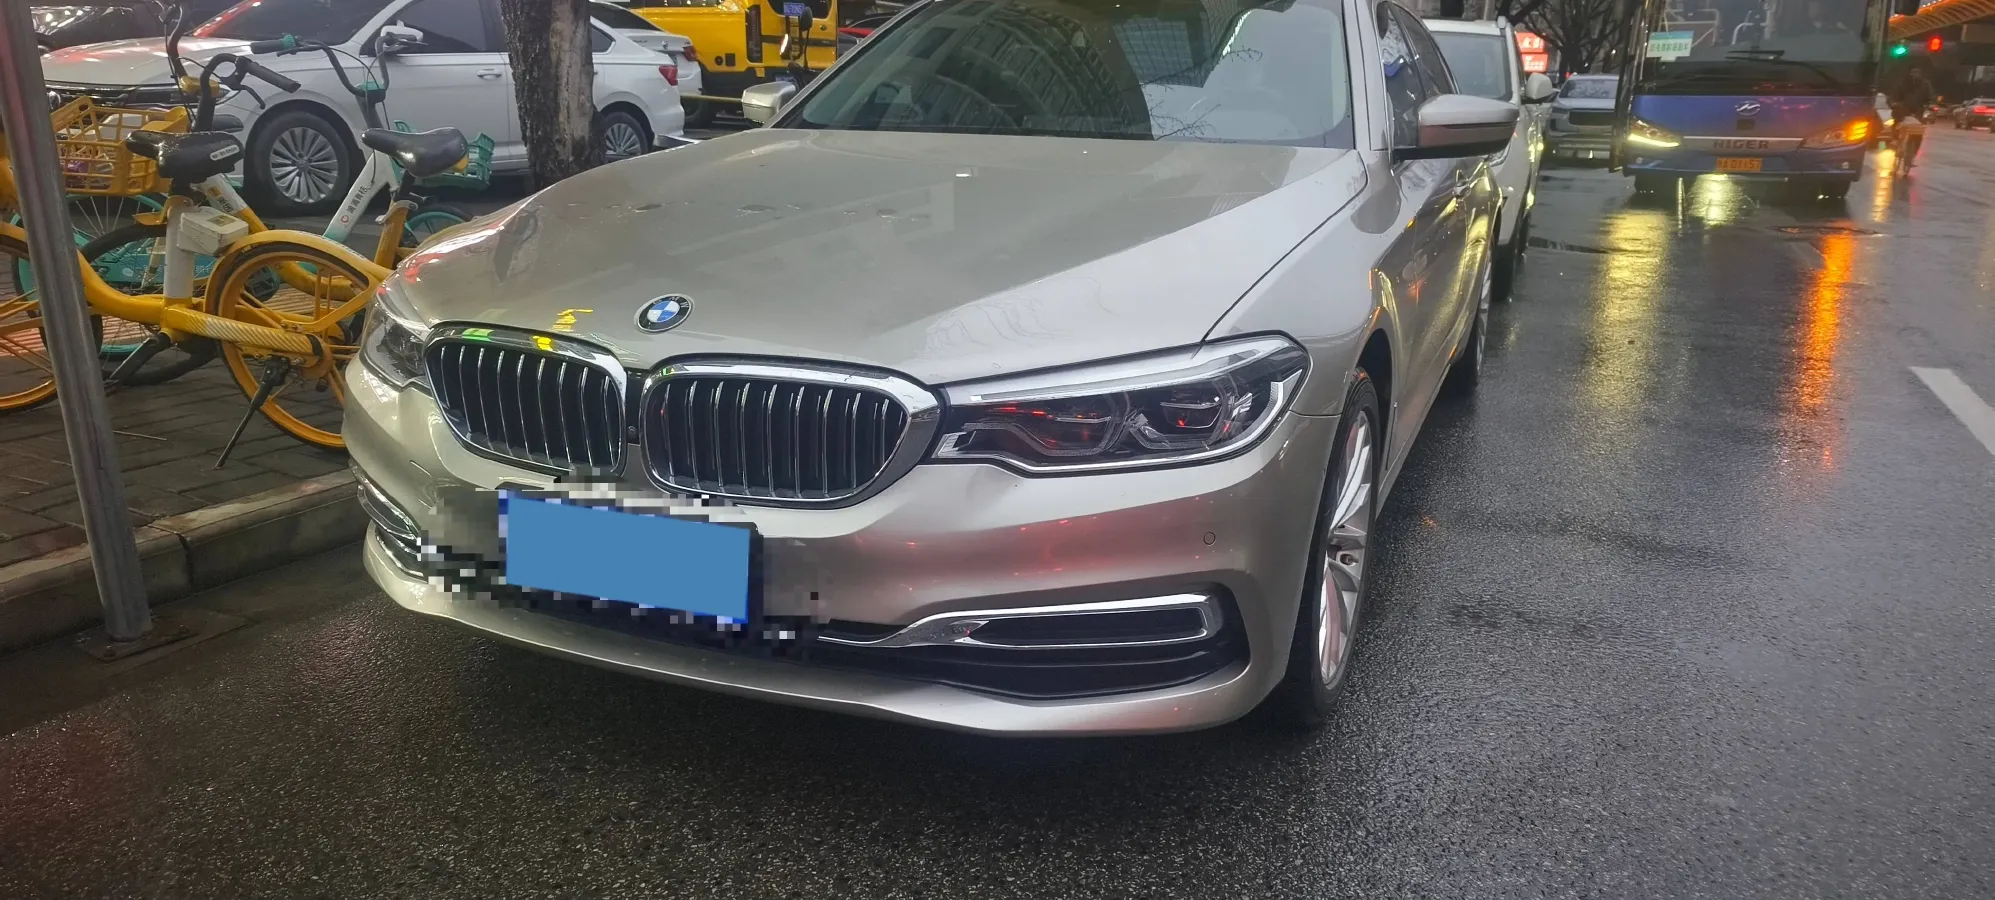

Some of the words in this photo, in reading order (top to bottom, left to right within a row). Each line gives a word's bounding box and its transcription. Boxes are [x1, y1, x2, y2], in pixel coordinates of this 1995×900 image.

[1713, 139, 1769, 149] HIGER
[346, 185, 368, 215] 滴滴青桔
